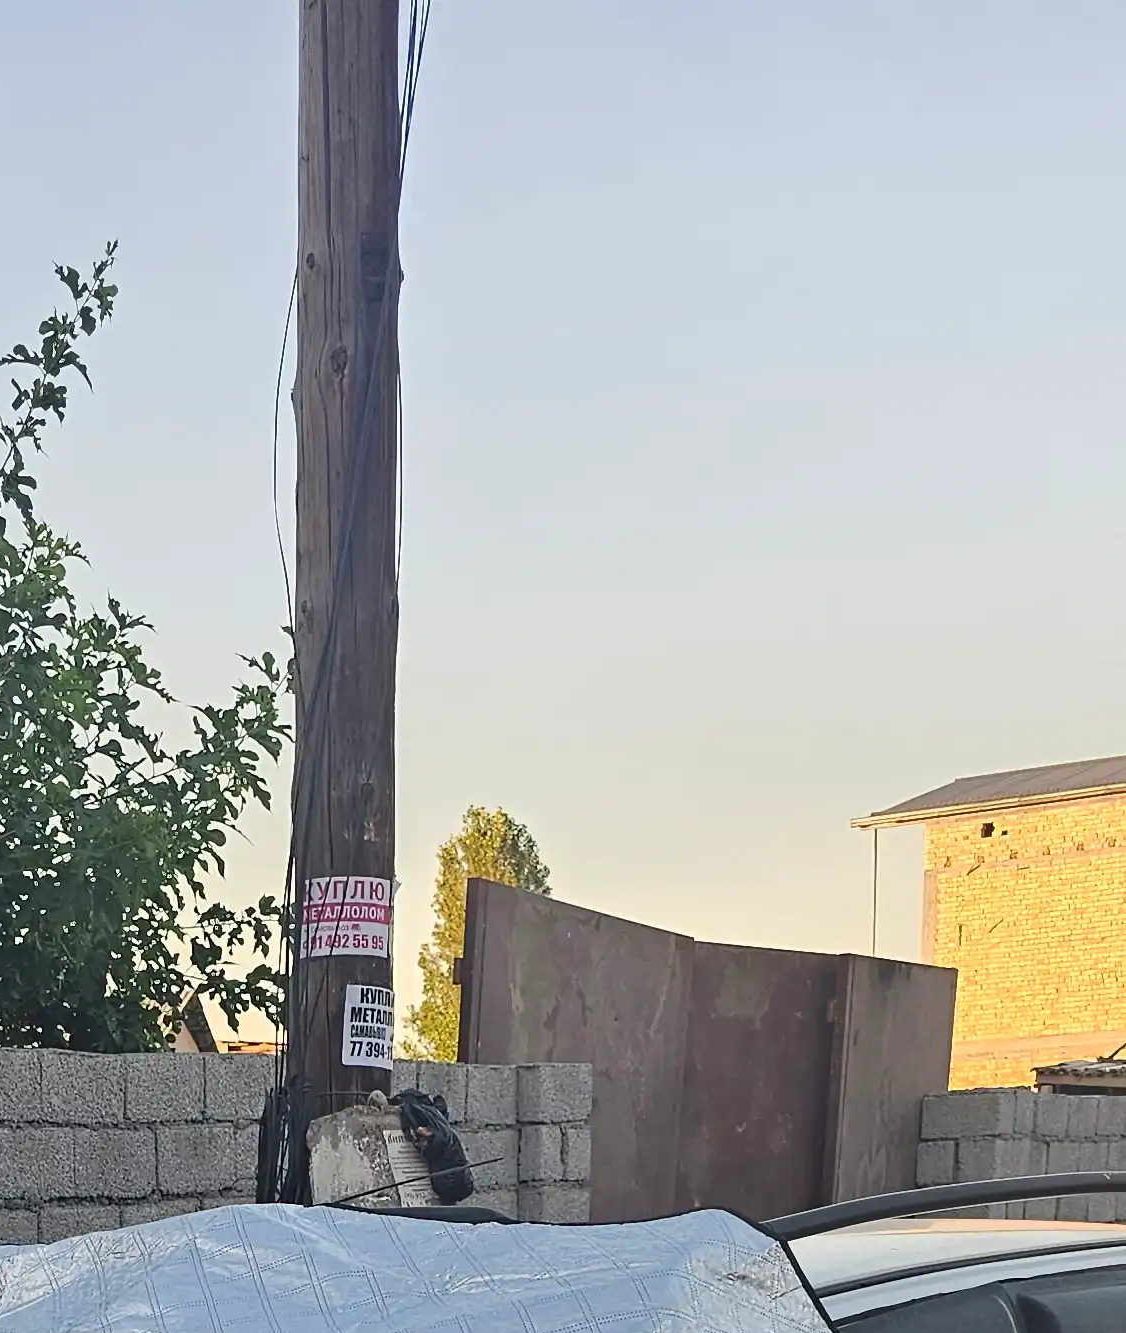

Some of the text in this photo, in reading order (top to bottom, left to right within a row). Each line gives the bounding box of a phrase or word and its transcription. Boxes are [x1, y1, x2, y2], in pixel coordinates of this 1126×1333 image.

[304, 880, 385, 902] КУПЛЮ
[303, 906, 385, 922] МЕТАЛЛОЛОМ
[353, 934, 369, 949] 55
[372, 935, 384, 950] 95
[350, 1007, 395, 1027] МЕТАЛЛ
[350, 1041, 363, 1057] 77
